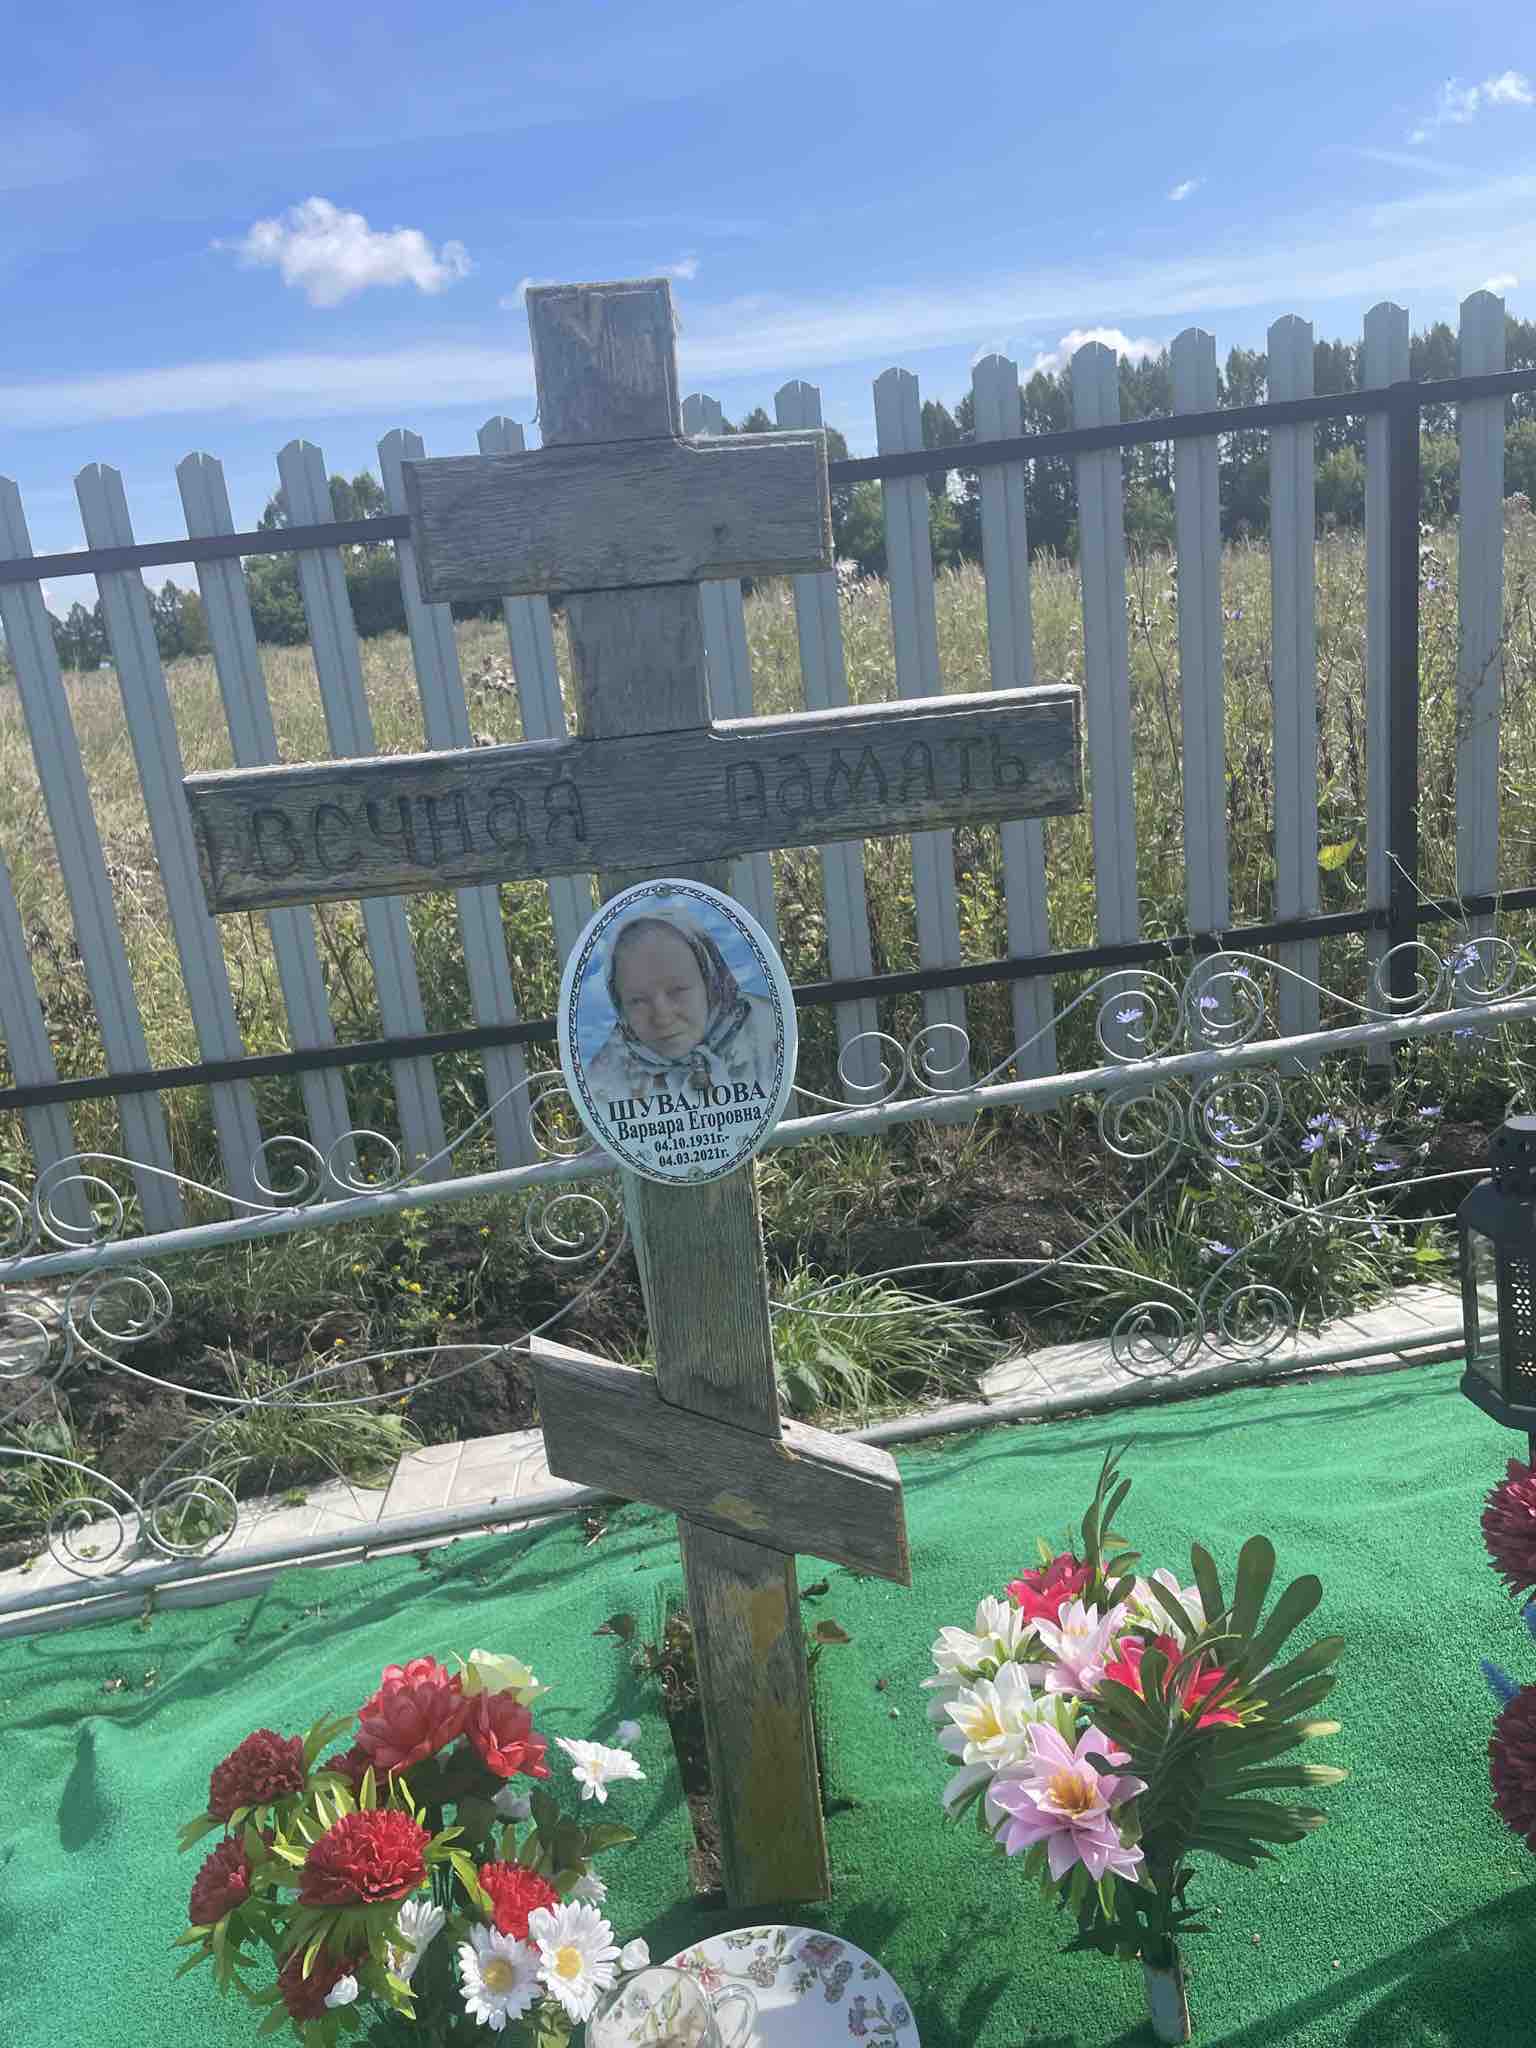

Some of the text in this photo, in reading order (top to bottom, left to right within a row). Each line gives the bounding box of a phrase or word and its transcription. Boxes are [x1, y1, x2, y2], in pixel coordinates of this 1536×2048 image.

[607, 1080, 767, 1121] ШУВАЛОВА
[617, 1105, 762, 1143] Варвара Егоровна
